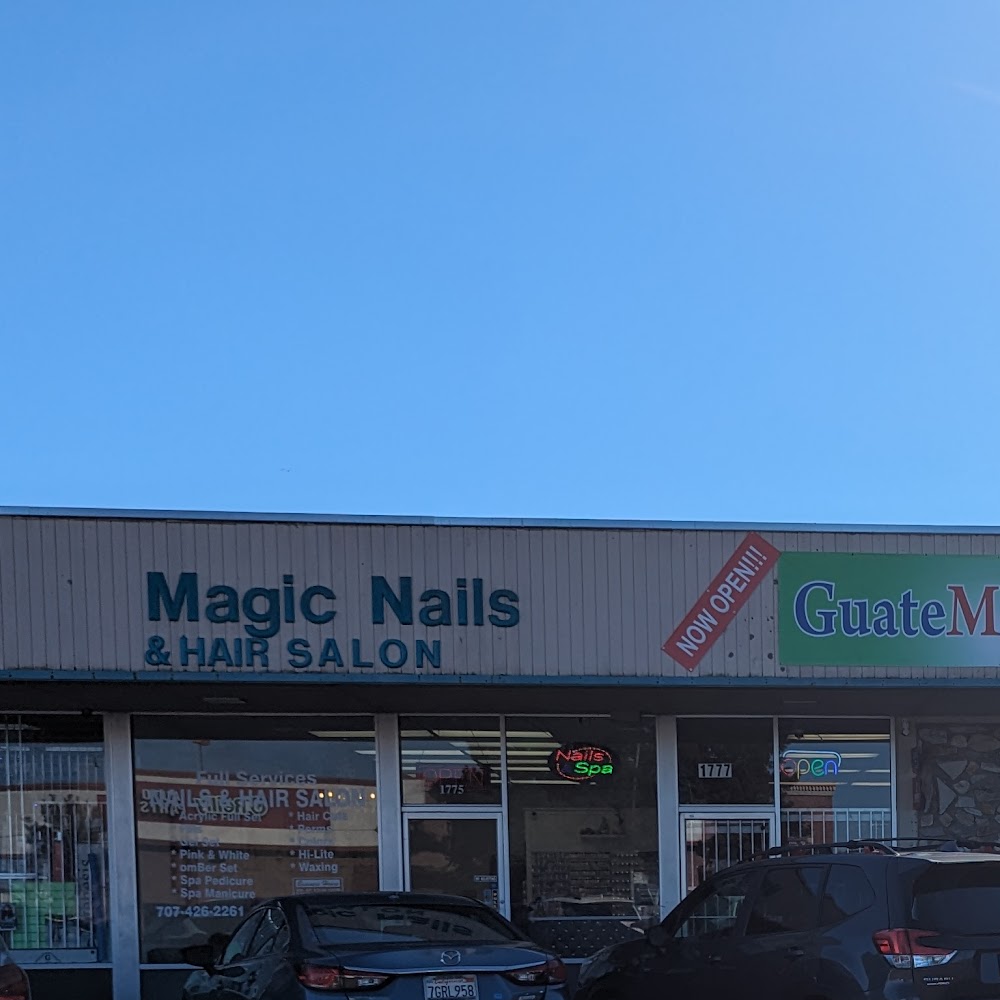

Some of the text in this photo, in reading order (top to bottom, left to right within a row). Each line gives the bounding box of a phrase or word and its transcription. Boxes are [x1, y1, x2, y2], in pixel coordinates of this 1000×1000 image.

[146, 571, 521, 639] Magic Nails
[675, 545, 767, 657] NOW OPEN!!!
[145, 635, 441, 669] & HAIR SALON
[555, 747, 605, 762] Nails
[573, 761, 614, 777] Spa
[700, 764, 731, 777] 1777
[196, 770, 318, 786] Full Services
[439, 784, 465, 795] 1775
[238, 788, 291, 808] HAIR
[179, 811, 218, 824] Acrylic
[220, 811, 240, 822] Full
[296, 811, 319, 821] Hair
[179, 849, 251, 860] Pink & White
[298, 849, 335, 860] Hi-Lite
[180, 862, 239, 873] omBer Set
[298, 861, 339, 874] Waxing
[180, 874, 255, 886] Spa Pedicure
[180, 887, 257, 900] Spa Manicure
[155, 905, 245, 918] 707-426-2261
[427, 985, 475, 998] 7GRL958
